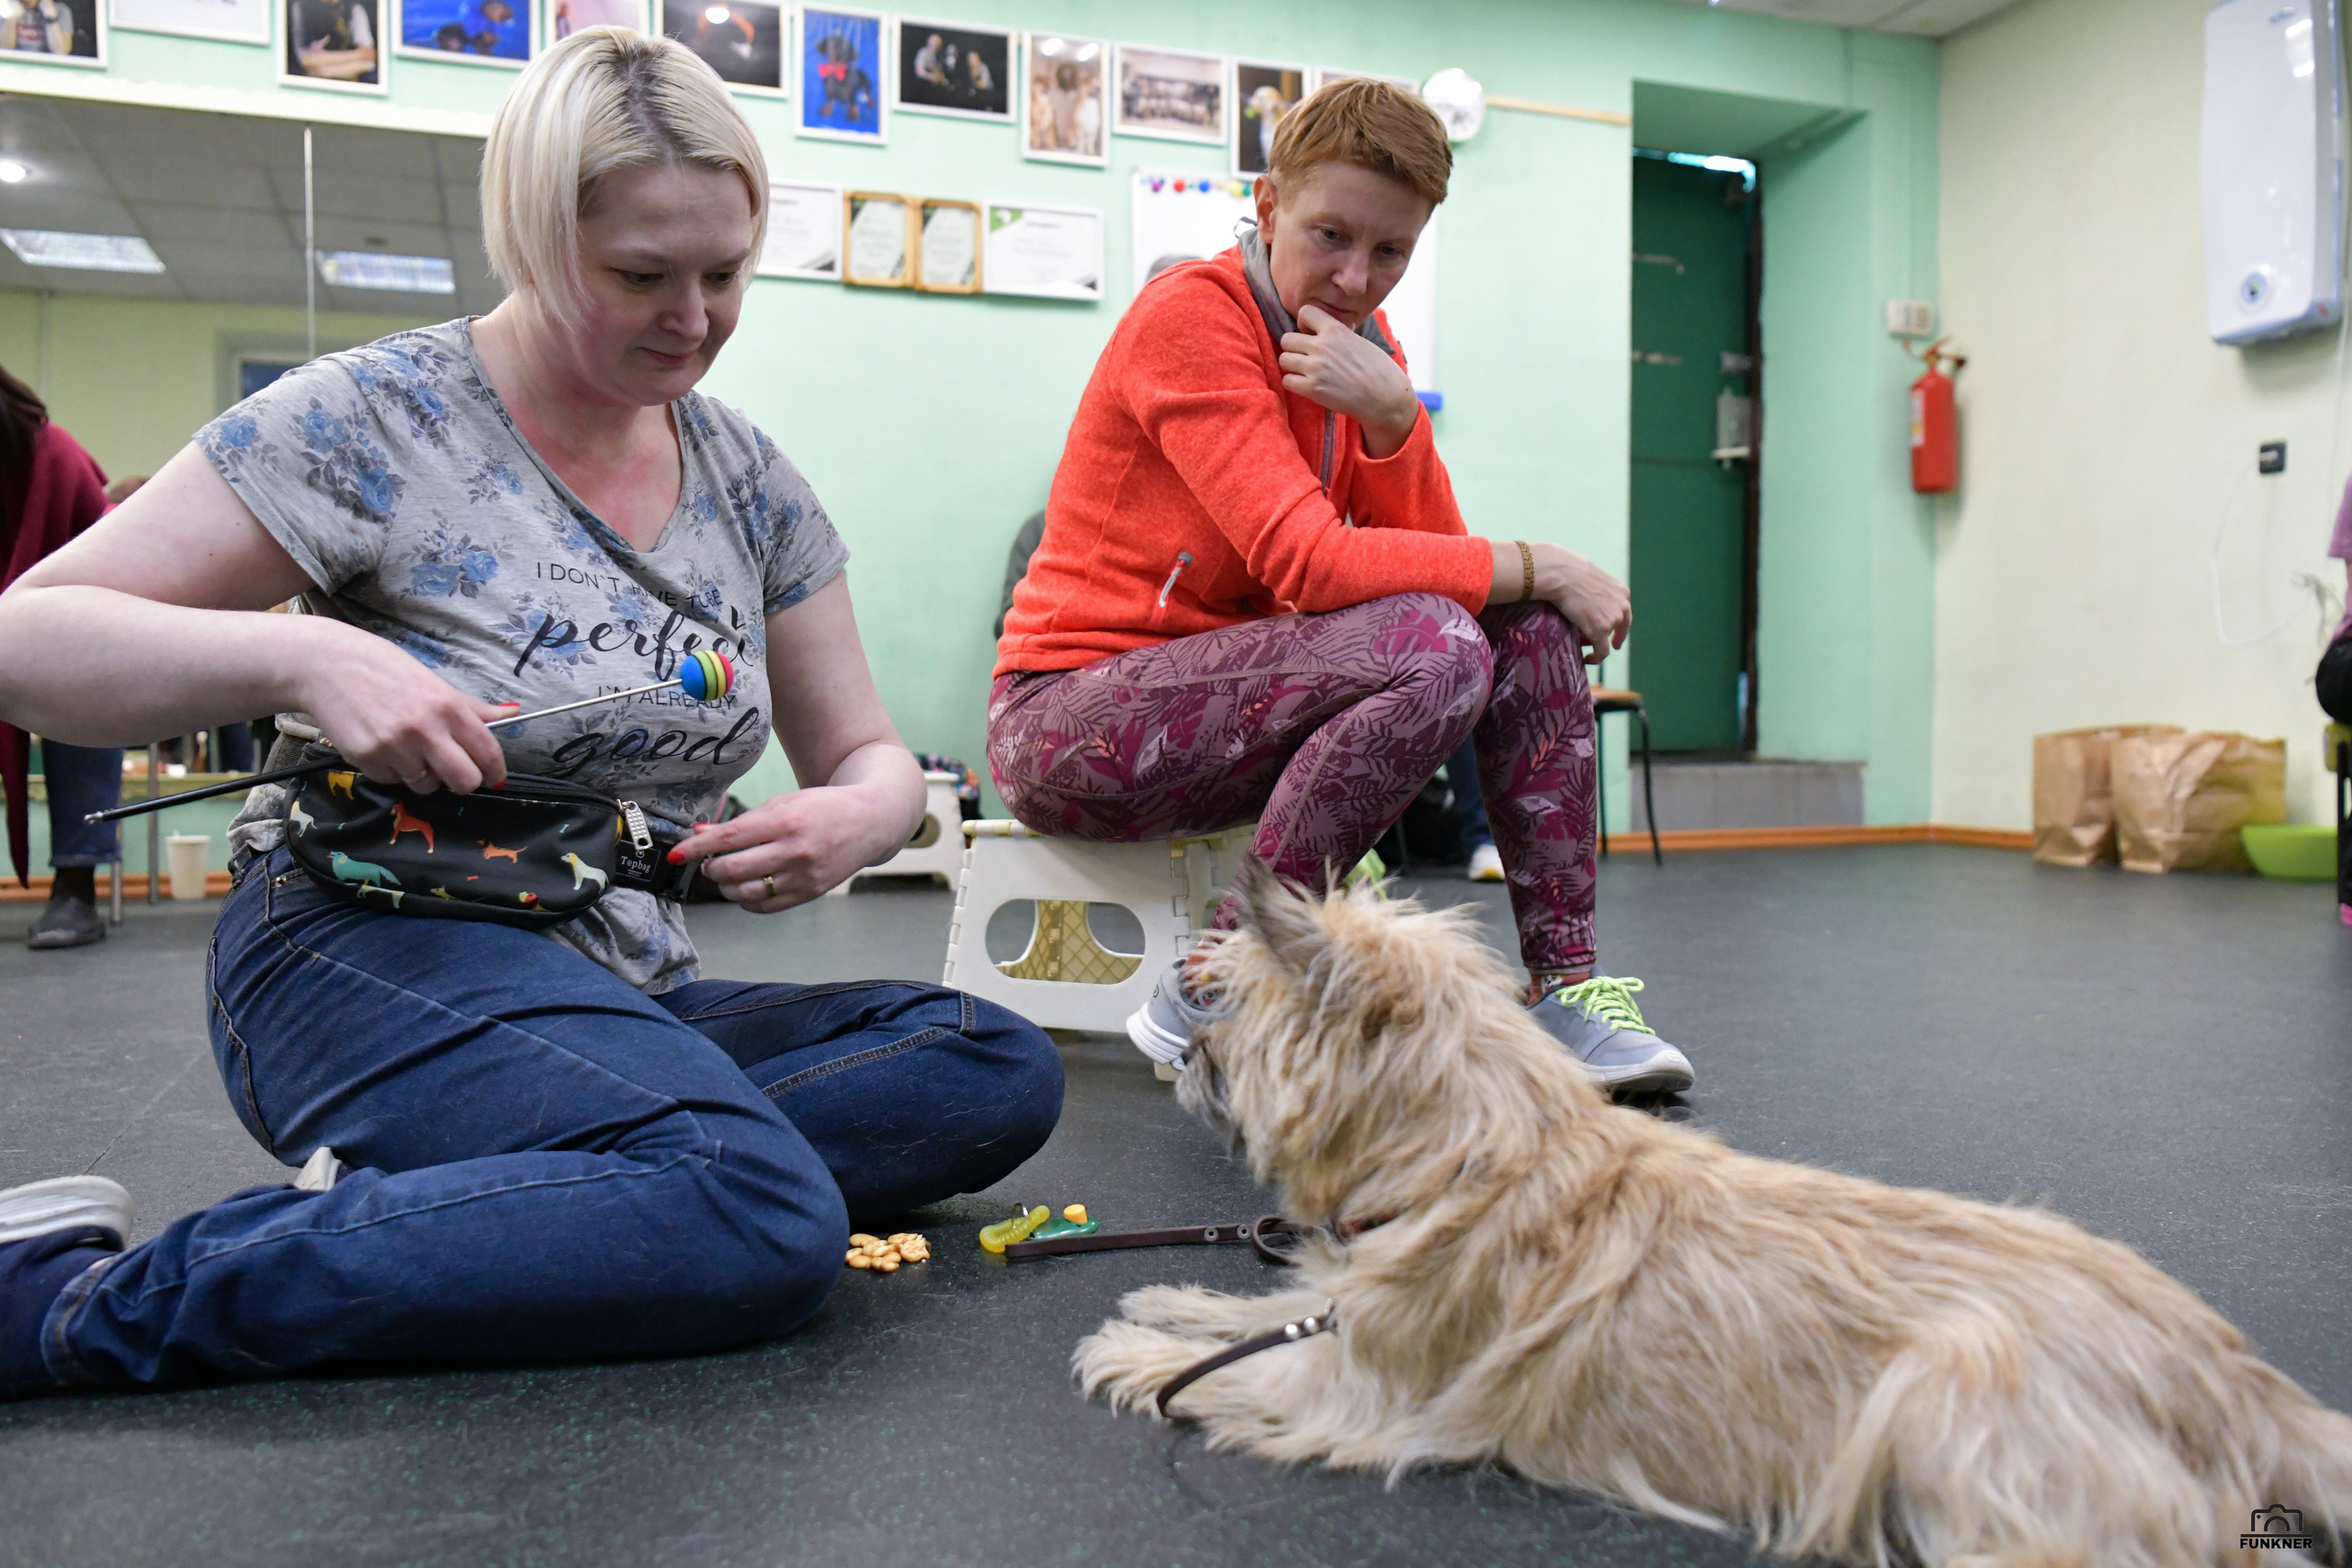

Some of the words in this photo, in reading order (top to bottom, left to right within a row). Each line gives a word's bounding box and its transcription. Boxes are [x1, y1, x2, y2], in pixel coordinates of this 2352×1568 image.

[537, 562, 542, 579] I
[630, 580, 678, 606] HVE
[706, 588, 724, 607] BE
[535, 706, 760, 779] good
